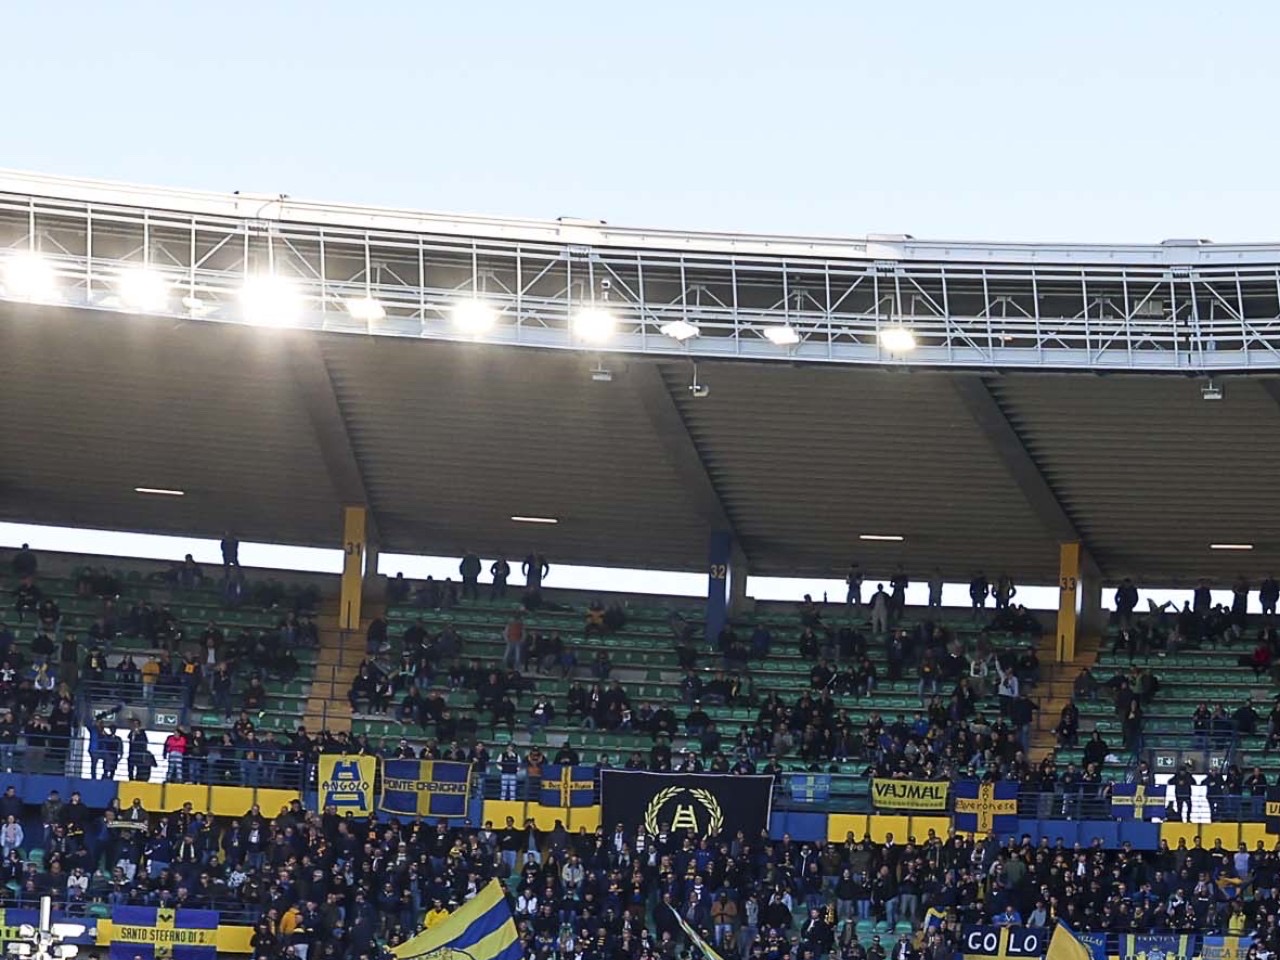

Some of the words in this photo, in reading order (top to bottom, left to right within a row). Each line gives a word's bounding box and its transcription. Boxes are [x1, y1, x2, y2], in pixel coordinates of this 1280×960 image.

[346, 542, 361, 556] 31
[710, 565, 725, 579] 32
[1061, 577, 1076, 590] 33
[121, 928, 147, 941] SANTO
[149, 929, 187, 943] STEFANO
